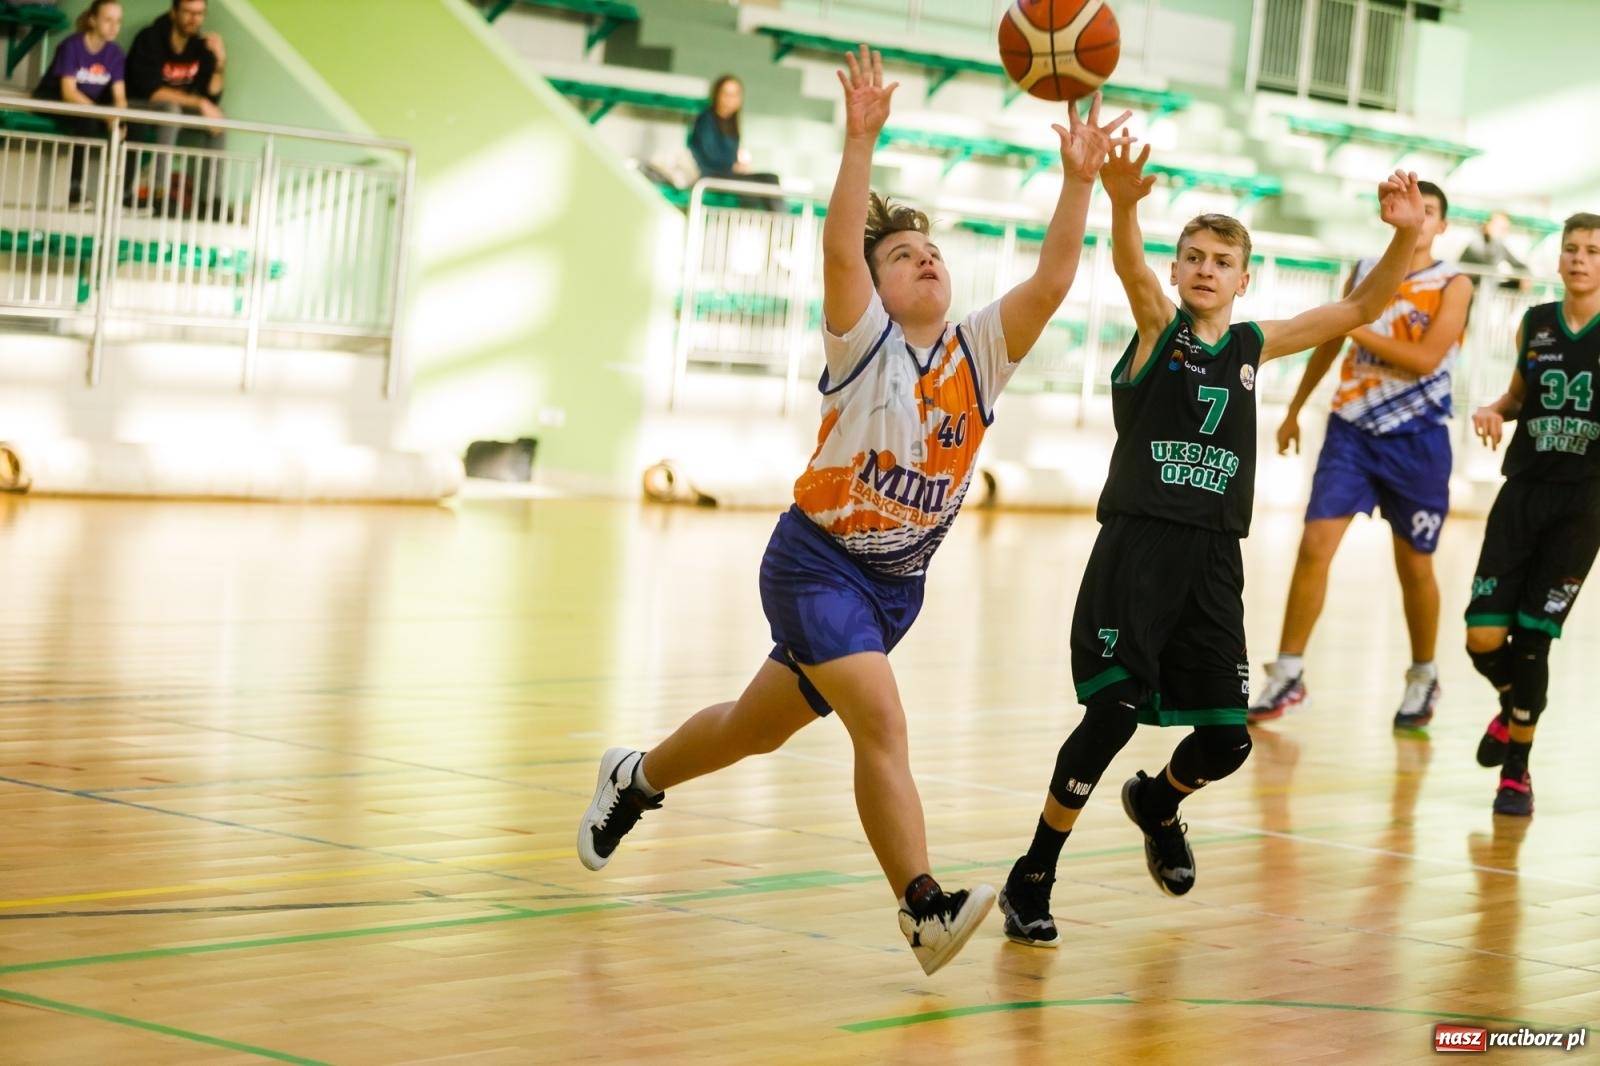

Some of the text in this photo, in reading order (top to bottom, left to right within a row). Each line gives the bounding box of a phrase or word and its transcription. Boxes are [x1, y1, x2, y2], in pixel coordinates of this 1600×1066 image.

[1540, 368, 1594, 412] 34
[1197, 385, 1229, 435] 7
[1526, 415, 1562, 437] UKS
[937, 412, 967, 449] 40
[1535, 433, 1589, 456] OPOLE
[1151, 440, 1202, 464] UKS
[858, 448, 951, 514] MINI
[1160, 462, 1229, 495] OPOLE
[1411, 509, 1441, 541] 99
[1098, 628, 1119, 658] 7
